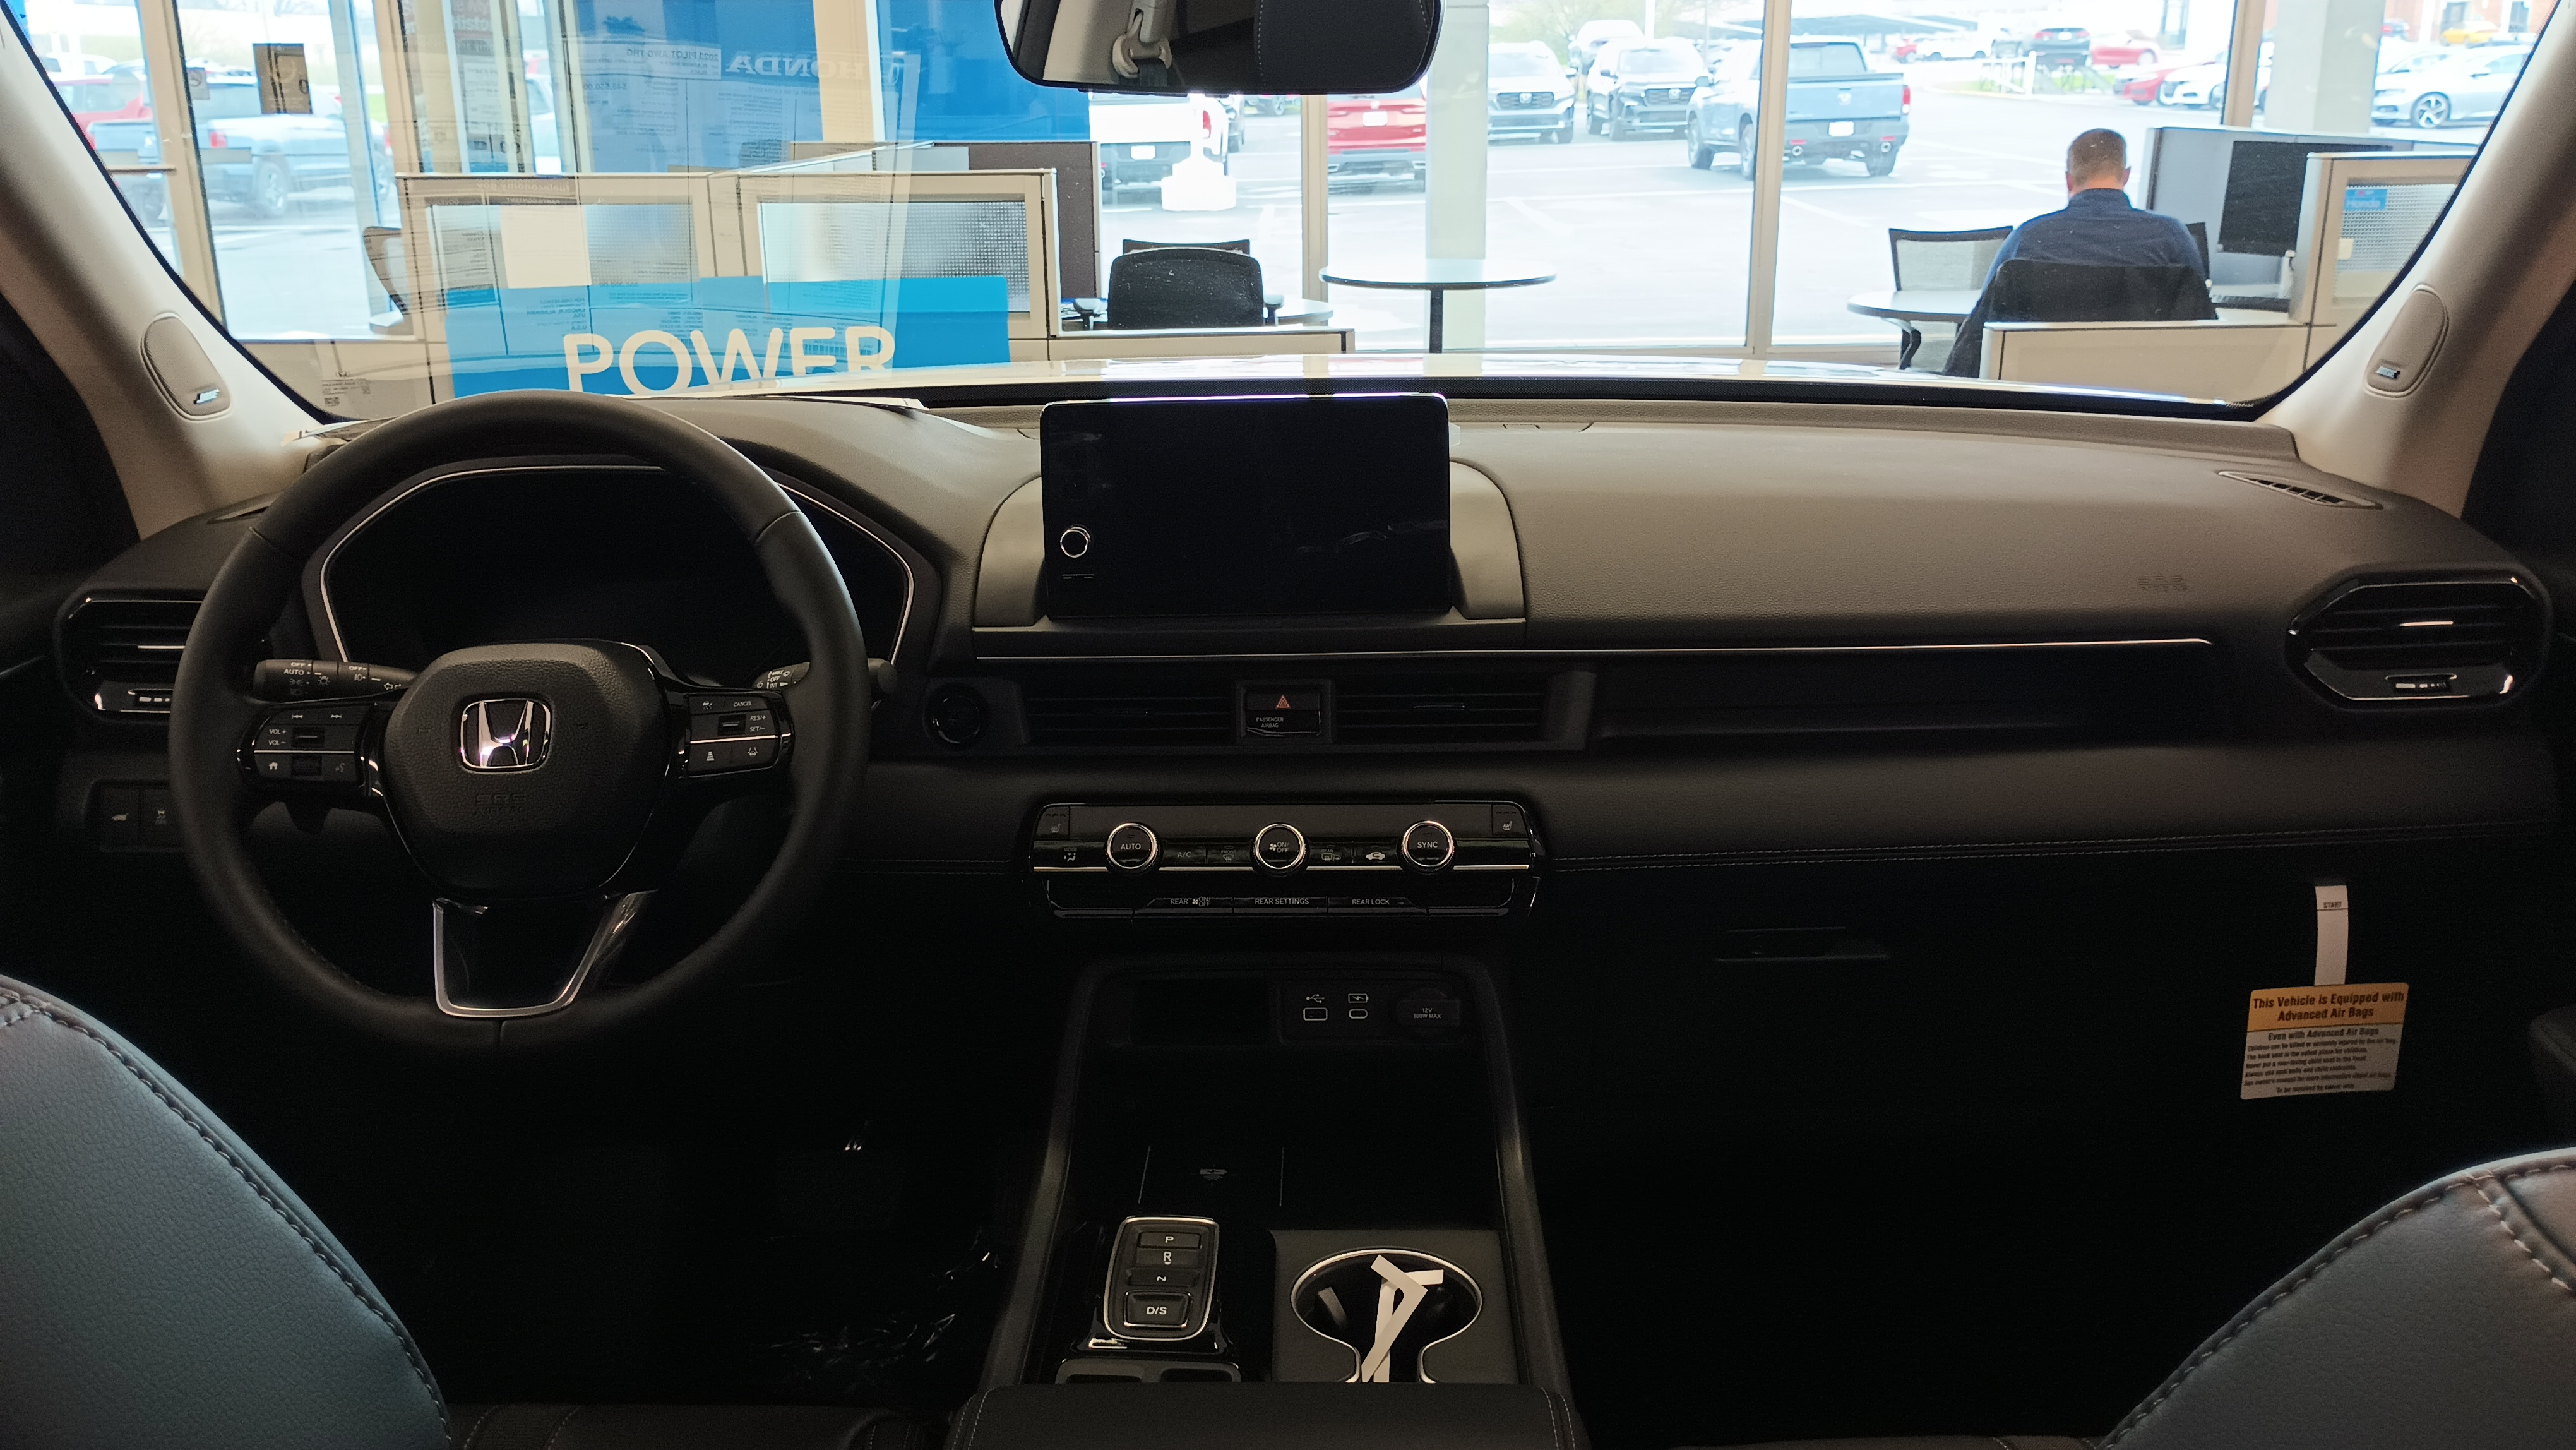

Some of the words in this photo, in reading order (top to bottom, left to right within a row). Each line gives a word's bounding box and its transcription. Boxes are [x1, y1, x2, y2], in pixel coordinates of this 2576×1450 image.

[564, 327, 895, 395] POWER
[1120, 842, 1142, 851] AUTO
[1255, 897, 1273, 906] REAR
[1275, 897, 1309, 906] SETTINGS
[2253, 998, 2274, 1009] This
[2277, 995, 2315, 1007] Vehicle
[2330, 992, 2380, 1006] Equipped
[2382, 991, 2405, 1003] with
[2278, 1009, 2328, 1022] Advanced
[2330, 1007, 2346, 1019] Air
[2349, 1006, 2375, 1019] Bags
[2268, 1032, 2286, 1041] Even
[2288, 1030, 2305, 1040] with
[2306, 1028, 2344, 1038] Advanced
[2346, 1027, 2358, 1036] Air
[2359, 1027, 2380, 1036] Bags
[1165, 1235, 1174, 1243] P
[1163, 1251, 1172, 1262] R
[1146, 1305, 1167, 1315] D/S
